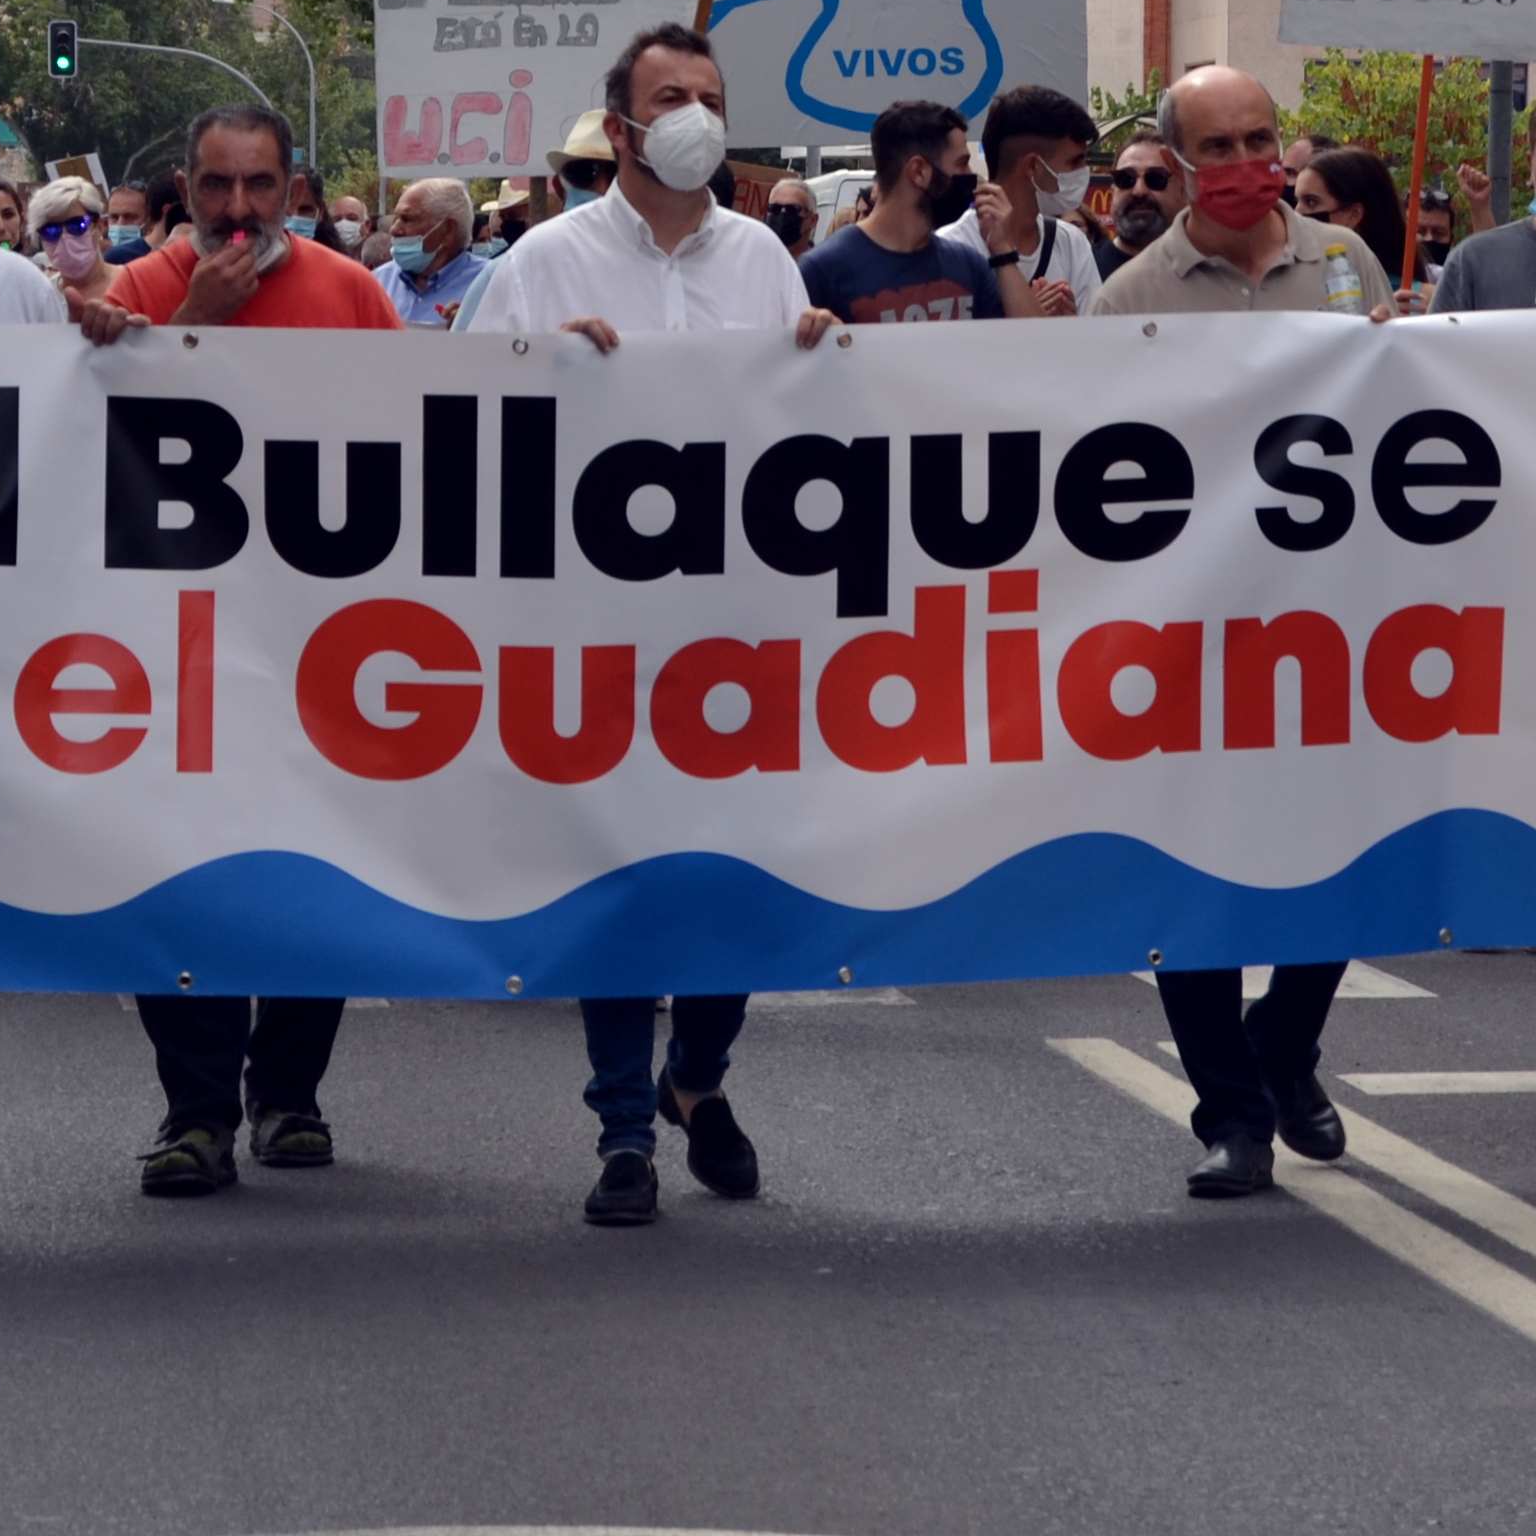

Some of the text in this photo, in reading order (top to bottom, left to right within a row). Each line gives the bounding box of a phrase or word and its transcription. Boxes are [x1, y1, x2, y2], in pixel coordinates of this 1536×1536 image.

[833, 46, 965, 78] VIVOS
[104, 393, 1195, 619] Bullaque
[1254, 408, 1502, 552] se
[13, 589, 215, 775] el
[295, 568, 1506, 785] Guadiana
